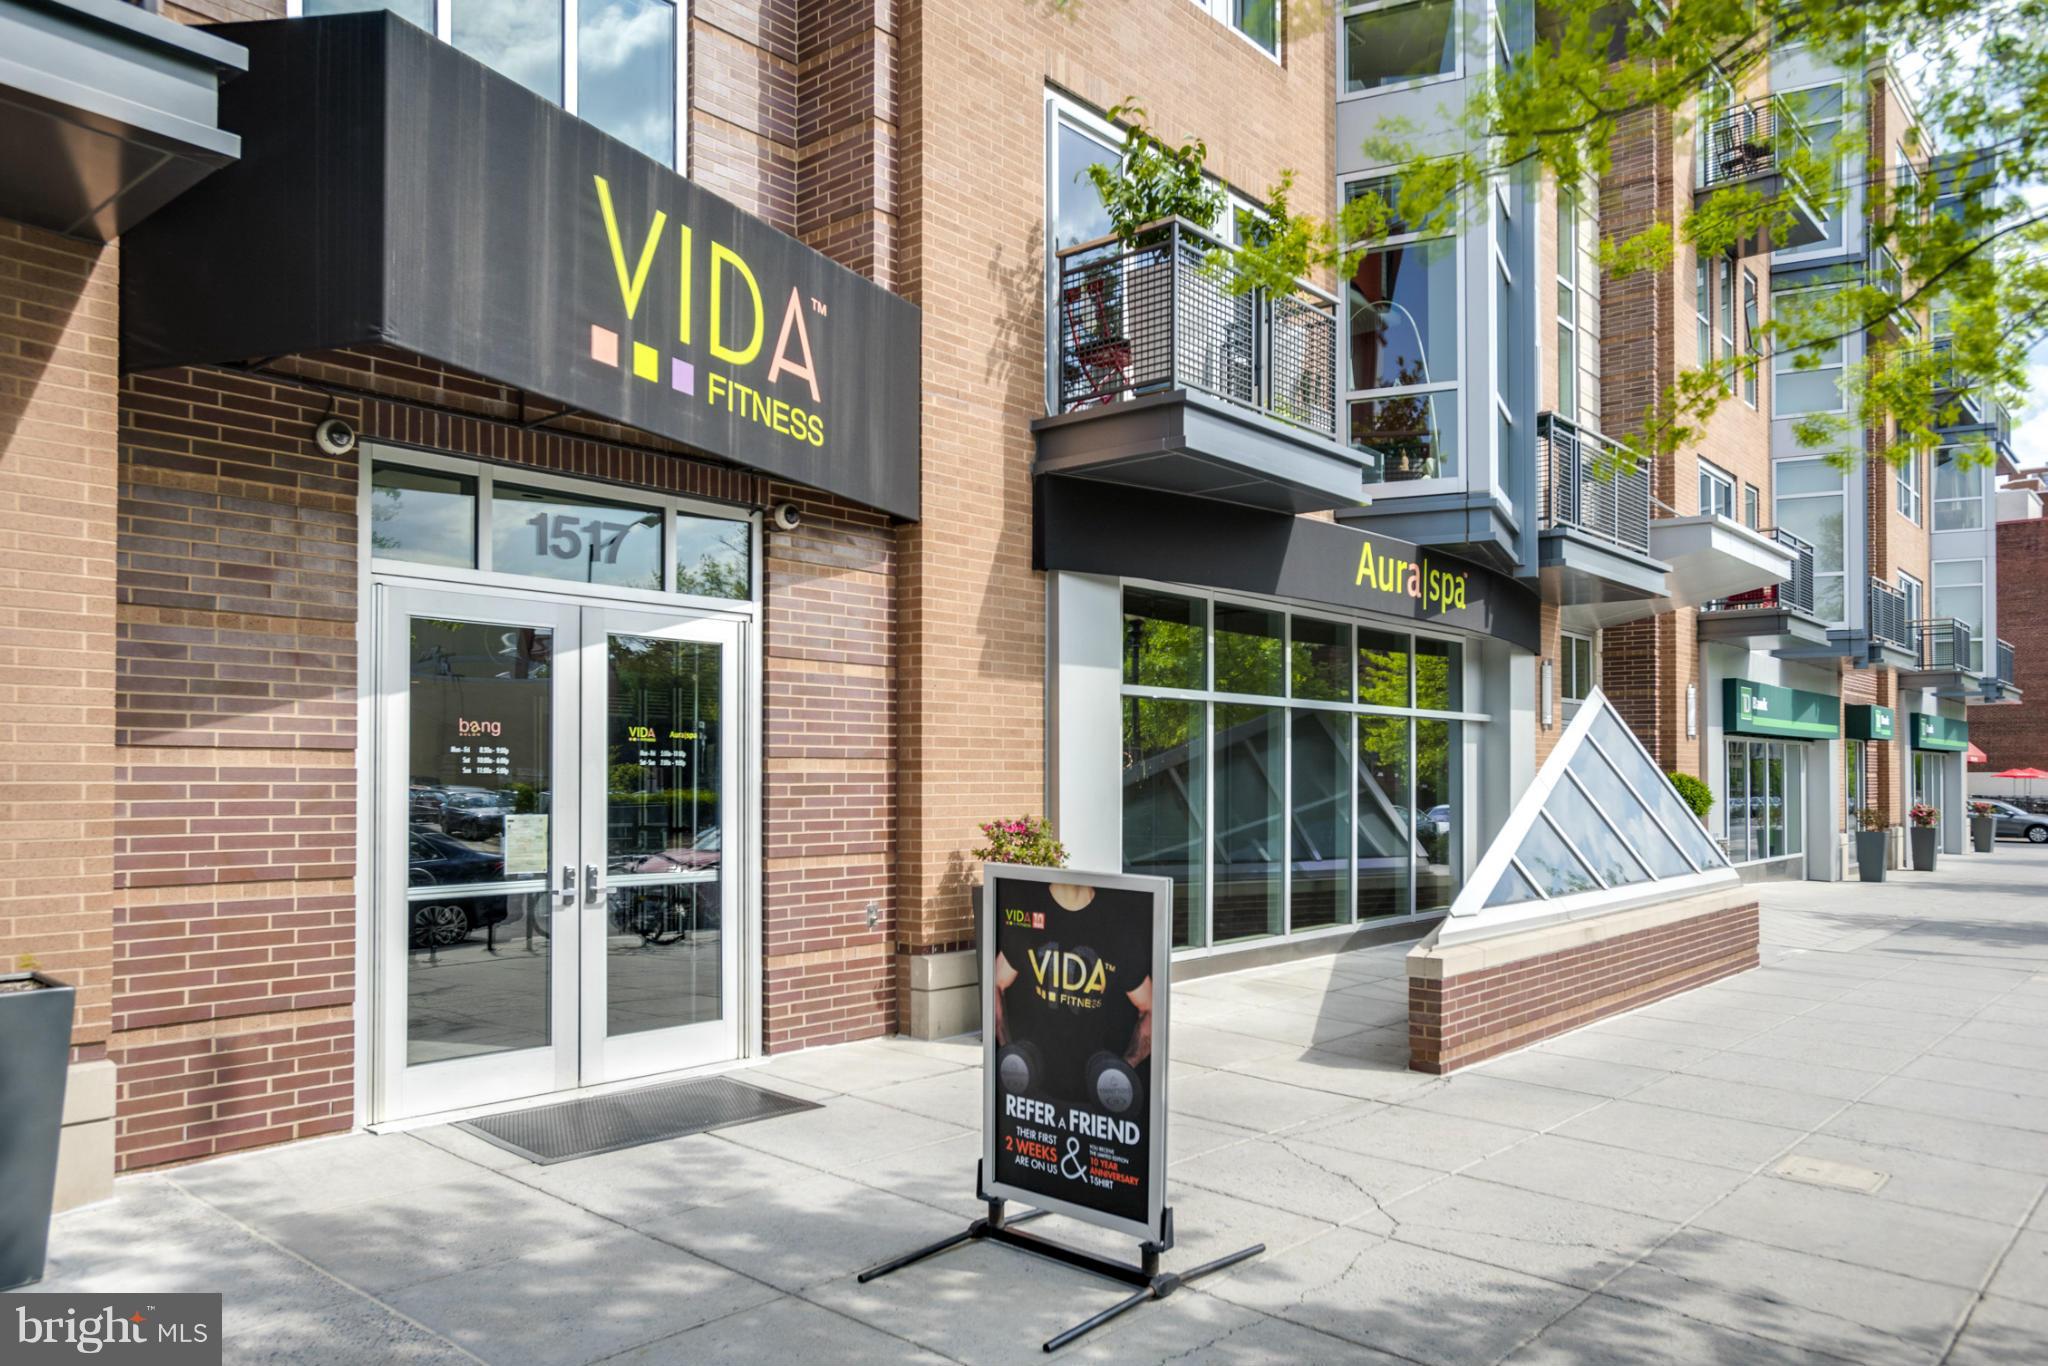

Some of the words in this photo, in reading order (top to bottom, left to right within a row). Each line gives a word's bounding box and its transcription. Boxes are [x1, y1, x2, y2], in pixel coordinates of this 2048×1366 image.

[594, 175, 821, 403] VIDA
[709, 372, 825, 447] FITNESS
[527, 512, 630, 564] 1517
[459, 717, 501, 736] bang
[628, 726, 656, 738] VIDA
[1005, 909, 1031, 923] VIDA
[1028, 949, 1107, 994] VIDA
[1006, 1093, 1056, 1128] REFER
[1058, 1117, 1067, 1130] A
[1069, 1108, 1141, 1146] FRIEND
[1016, 1126, 1037, 1140] THEIR
[1038, 1131, 1057, 1145] FIRST
[1005, 1135, 1013, 1151] 2
[1016, 1137, 1058, 1163] WEEKS
[1061, 1136, 1088, 1184] &
[1015, 1155, 1029, 1168] ARE
[1031, 1159, 1045, 1171] ON
[1047, 1162, 1058, 1175] US
[1091, 1156, 1099, 1166] 10
[1100, 1159, 1118, 1171] YEAR
[1089, 1167, 1139, 1186] ANNIVERSARY
